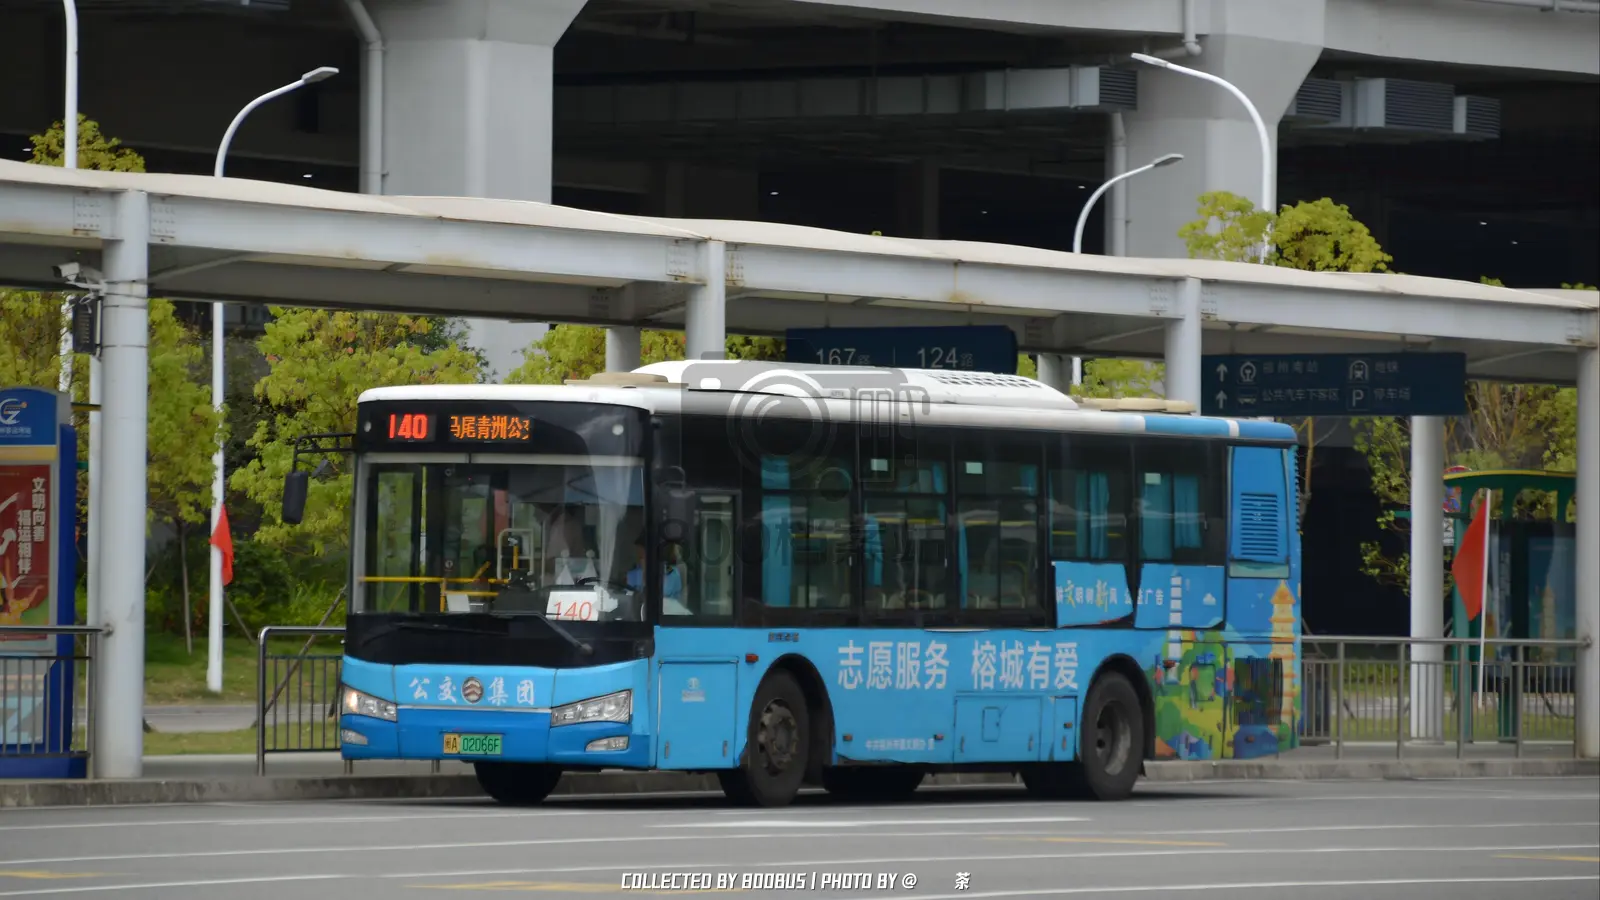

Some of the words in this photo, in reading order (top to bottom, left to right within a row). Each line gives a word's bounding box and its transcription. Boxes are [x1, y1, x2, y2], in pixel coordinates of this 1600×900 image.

[388, 413, 428, 439] 140
[32, 477, 46, 542] 文明向善
[18, 509, 32, 575] 福运相伴
[554, 601, 593, 622] 140
[837, 640, 950, 690] 志愿服务
[971, 640, 1079, 690] 榕城有爱
[408, 677, 458, 702] 公交
[488, 677, 536, 706] 集团
